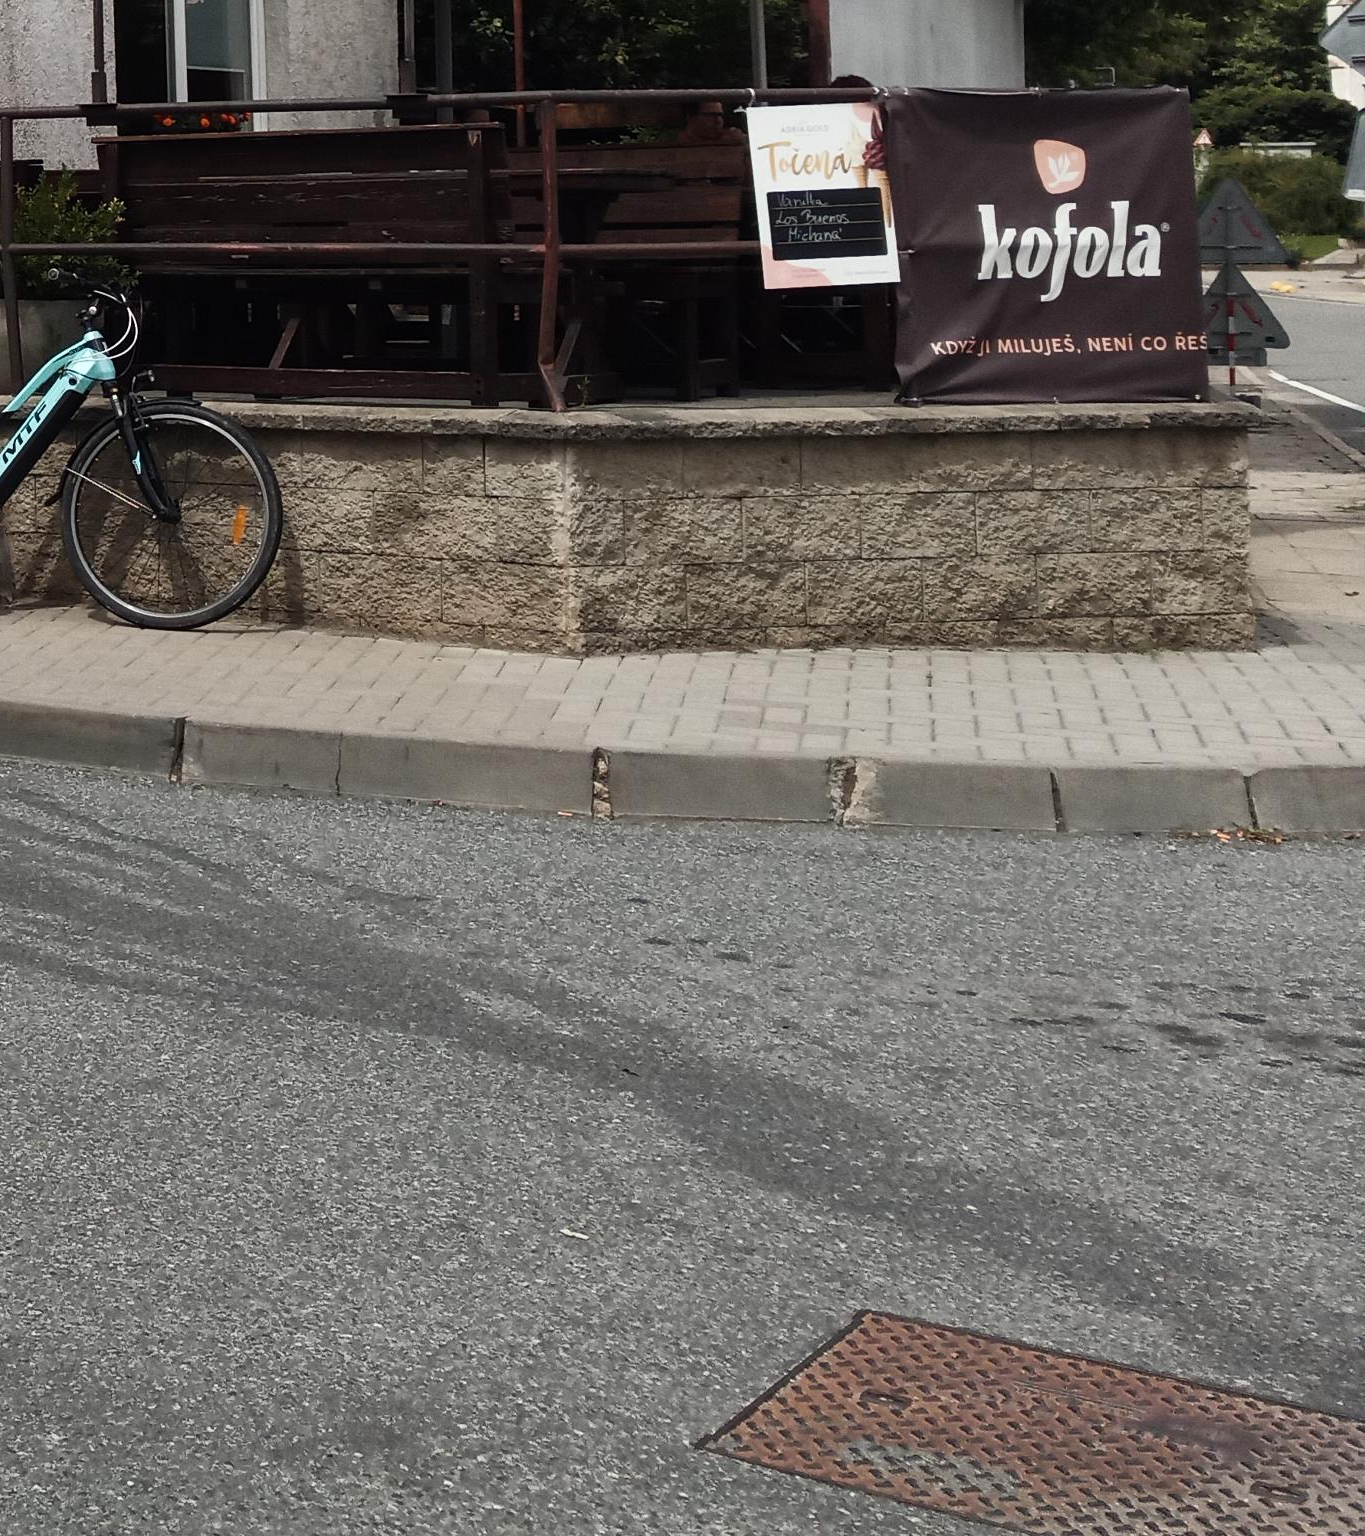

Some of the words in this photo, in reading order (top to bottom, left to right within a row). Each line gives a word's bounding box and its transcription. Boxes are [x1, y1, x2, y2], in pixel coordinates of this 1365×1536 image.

[757, 140, 852, 183] Točená
[978, 201, 1162, 303] kofola
[930, 336, 977, 355] KDYŽ
[977, 338, 990, 357] JI
[997, 333, 1082, 357] MILUJEŠ,
[1087, 333, 1134, 352] NENÍ
[1141, 336, 1168, 352] CO
[2, 399, 47, 465] MTF
